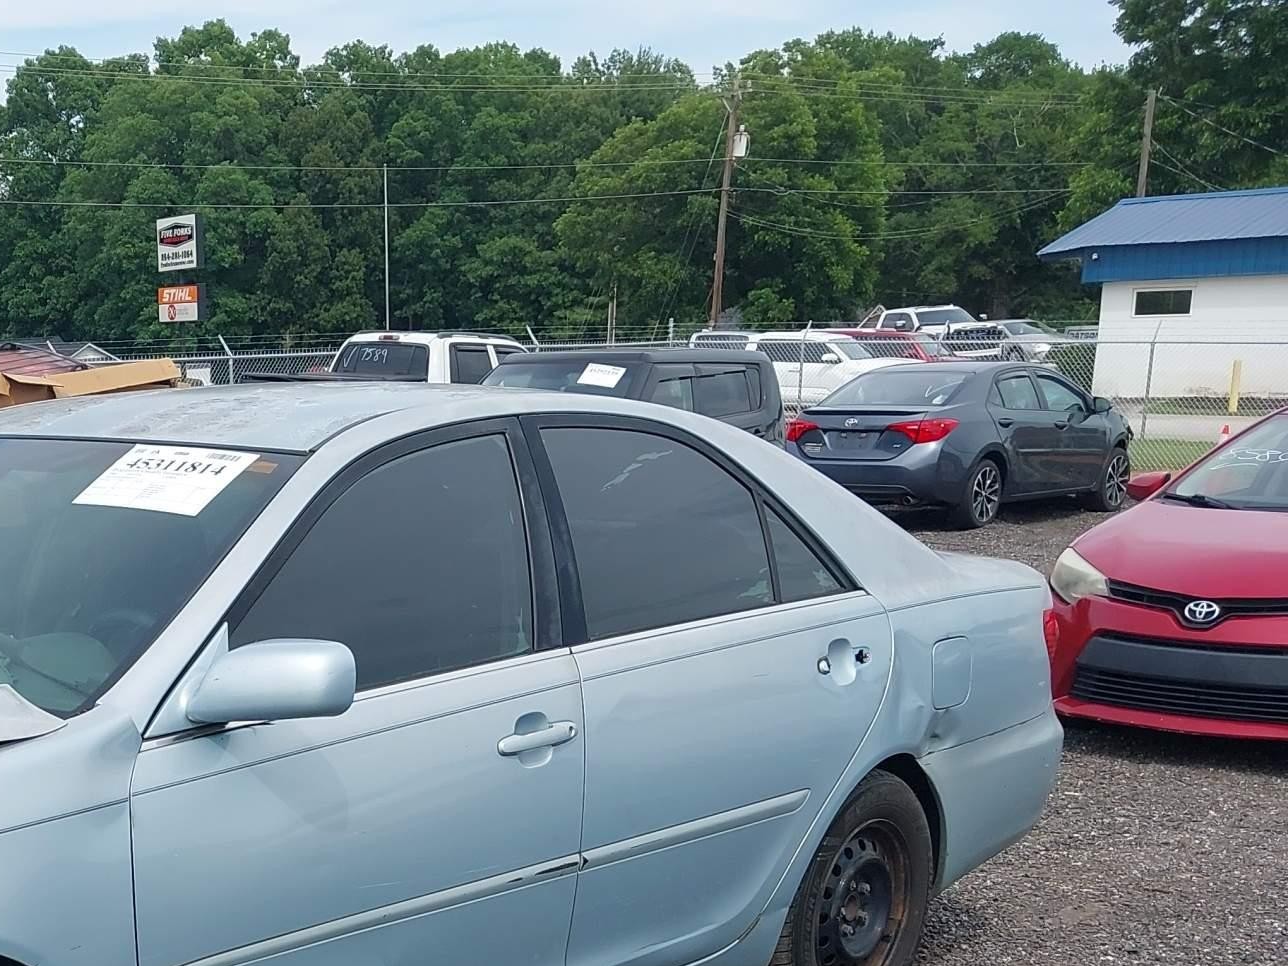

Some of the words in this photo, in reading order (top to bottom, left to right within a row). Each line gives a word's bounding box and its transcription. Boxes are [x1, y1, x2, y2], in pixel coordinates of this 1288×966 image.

[162, 288, 192, 302] STIHL
[361, 347, 388, 364] 7589
[126, 456, 228, 476] 45311814
